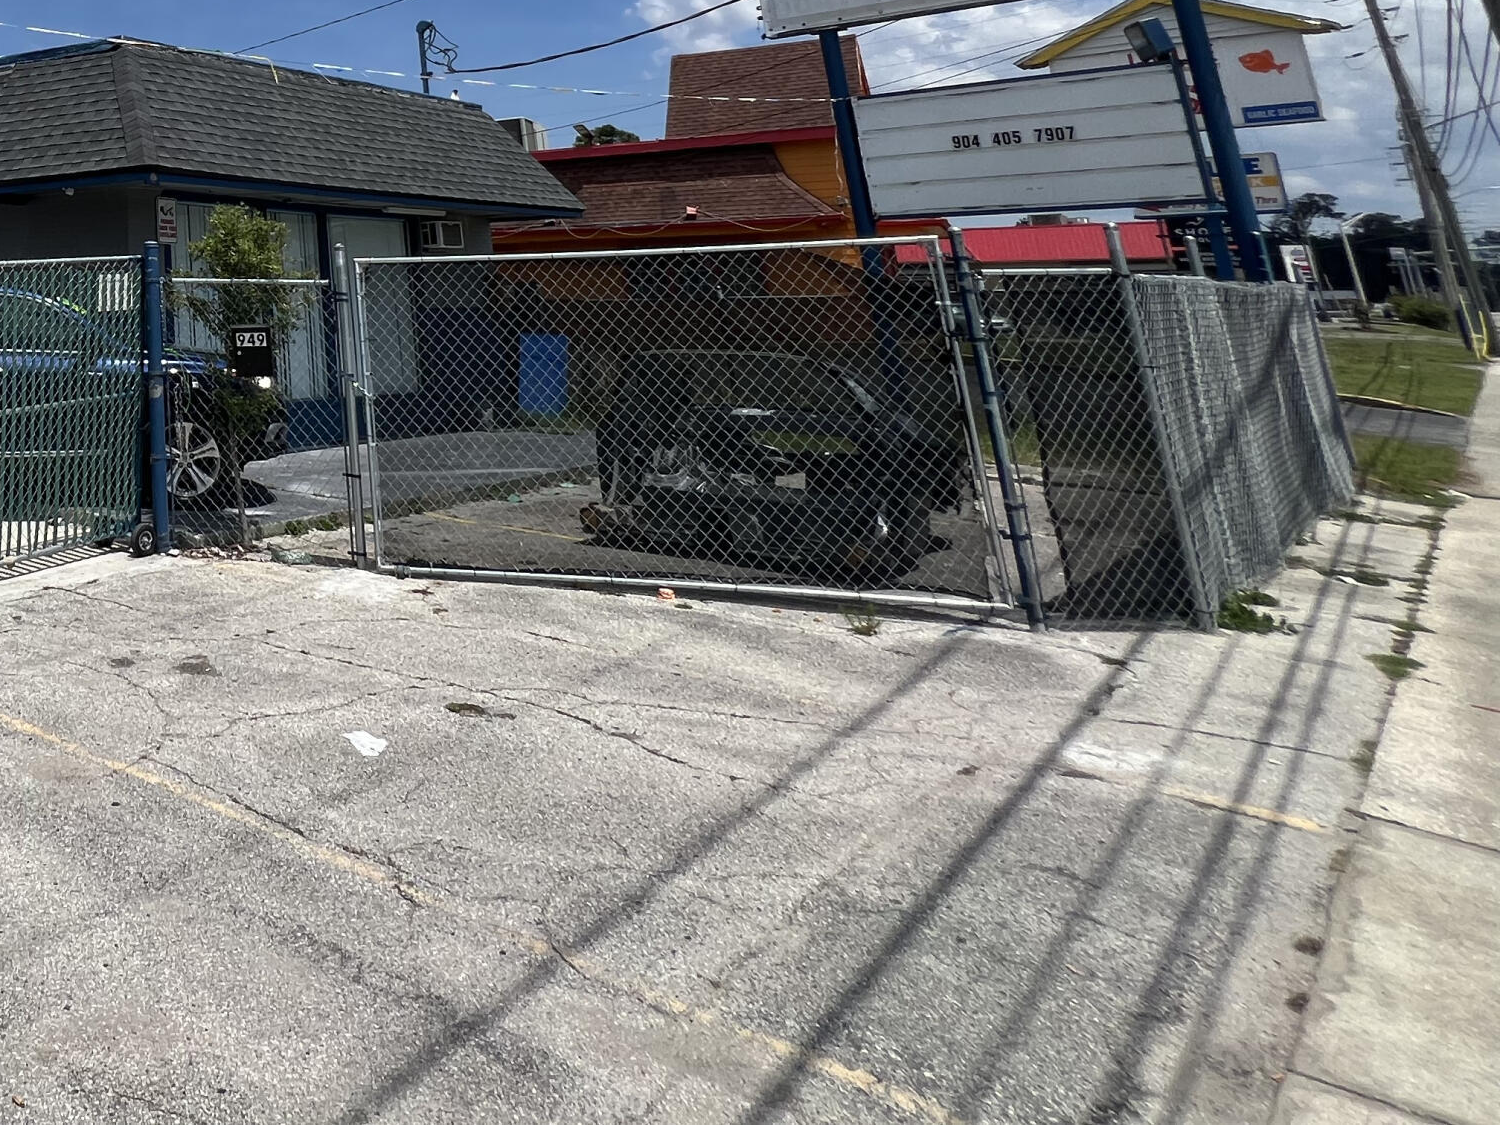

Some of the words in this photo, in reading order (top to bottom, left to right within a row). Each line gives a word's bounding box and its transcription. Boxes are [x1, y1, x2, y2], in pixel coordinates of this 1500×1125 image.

[951, 134, 980, 149] 904
[992, 130, 1022, 146] 405
[1033, 126, 1075, 142] 7907
[237, 333, 265, 346] 949
